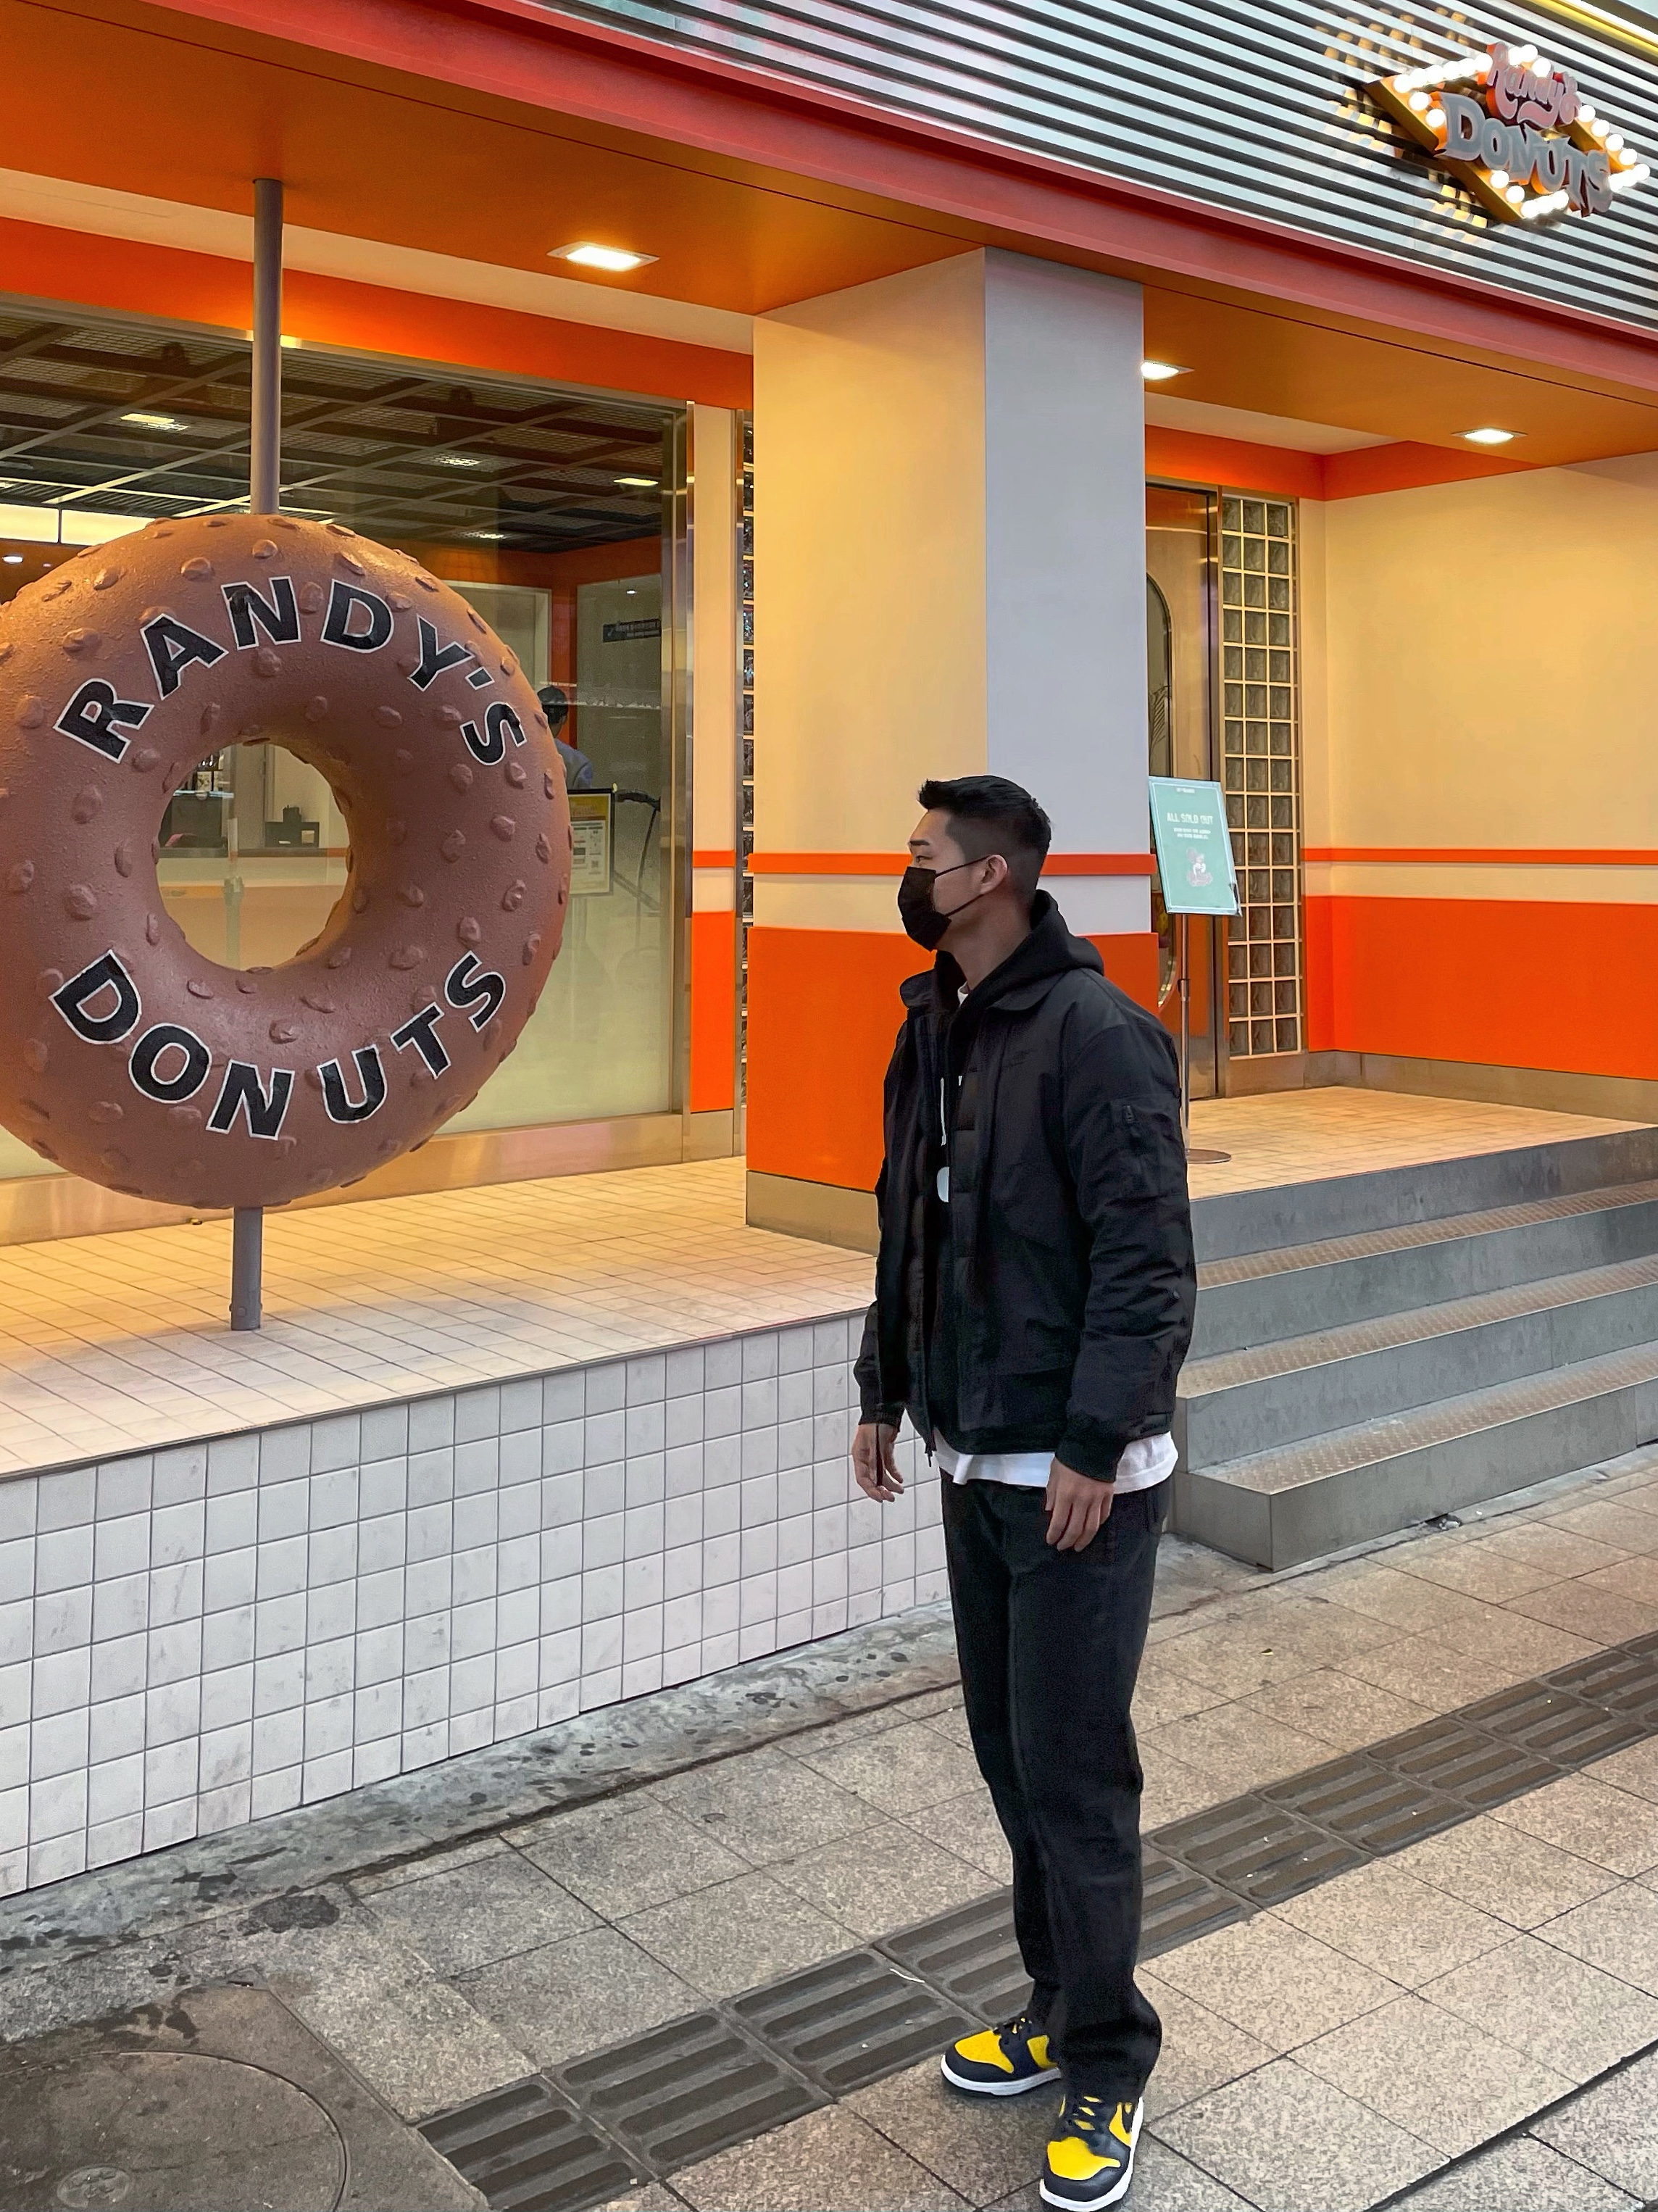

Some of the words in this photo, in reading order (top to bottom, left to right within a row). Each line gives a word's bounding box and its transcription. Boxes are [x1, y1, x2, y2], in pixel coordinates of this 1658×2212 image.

[1434, 91, 1613, 212] DONUTS
[54, 576, 525, 766] RANDY'S
[1167, 812, 1180, 823] ALL
[1180, 812, 1199, 824] SOLD
[1200, 815, 1214, 825] OUT
[49, 949, 506, 1140] DONUTS
